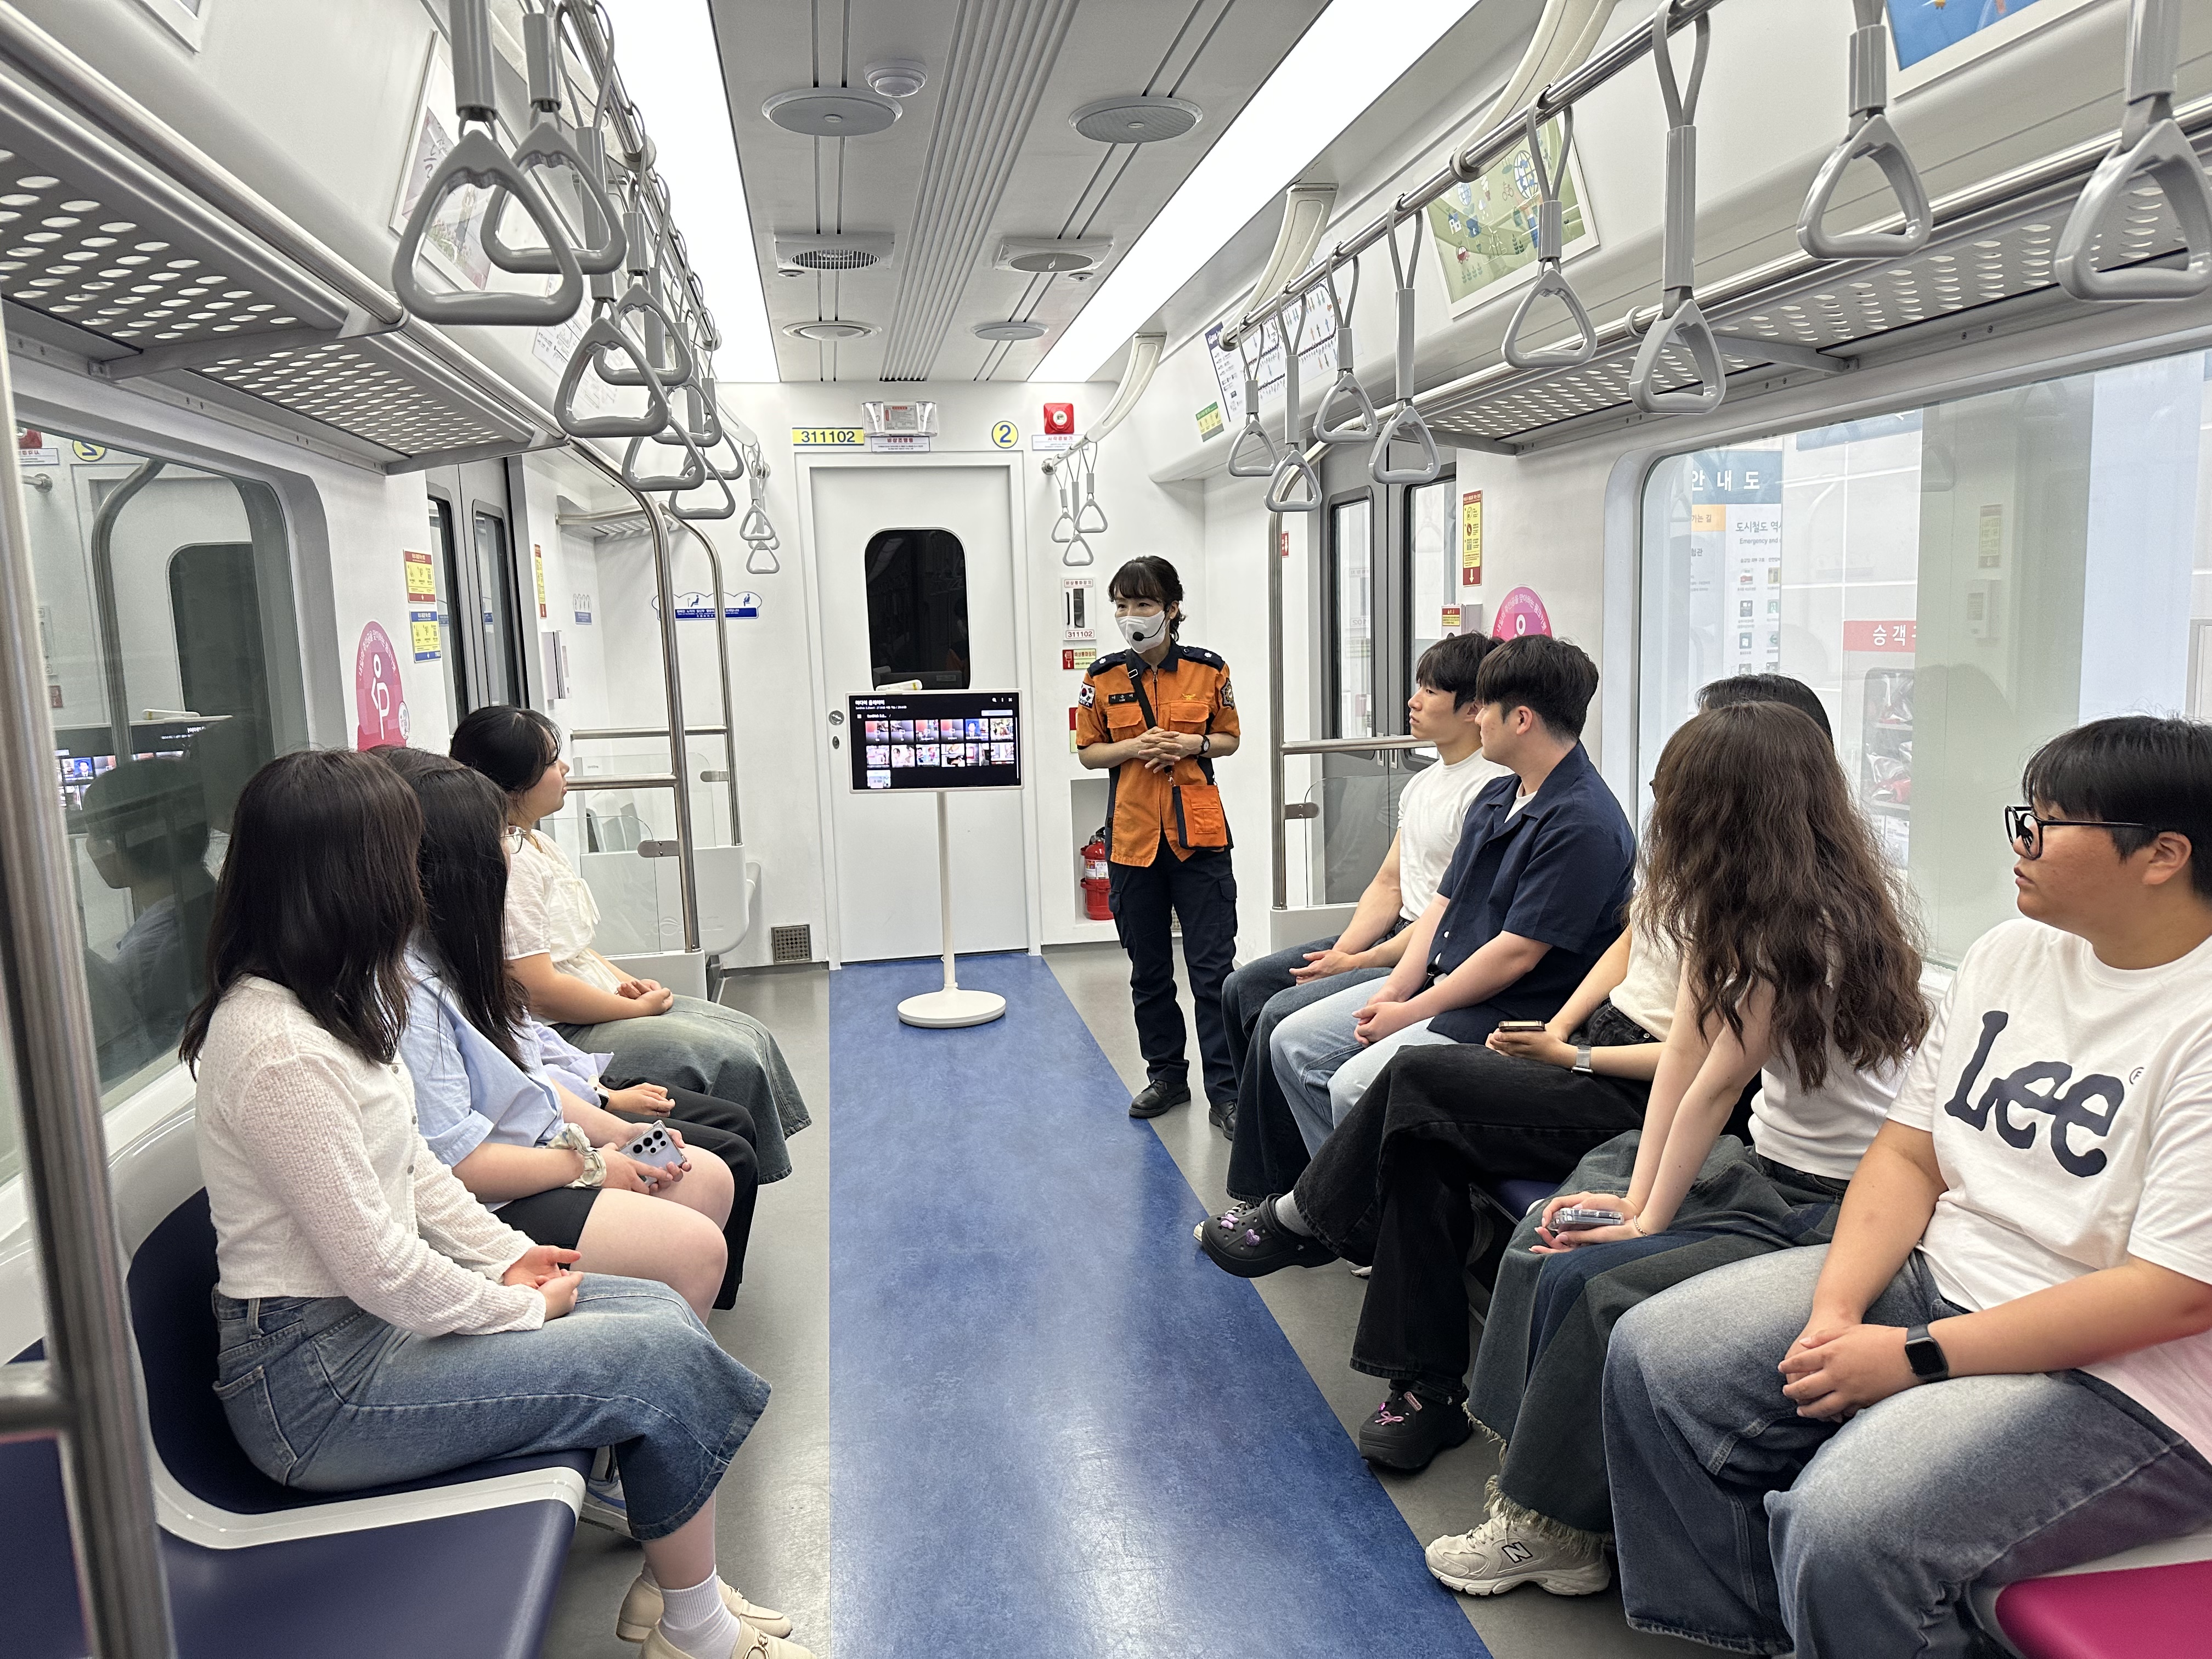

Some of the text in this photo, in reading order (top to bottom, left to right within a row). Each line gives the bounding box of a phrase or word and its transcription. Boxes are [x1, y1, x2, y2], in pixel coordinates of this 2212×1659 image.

[801, 431, 855, 443] 311102
[999, 425, 1012, 443] 2
[1735, 522, 1768, 533] 도시철도
[1944, 1011, 2125, 1177] Lee
[1502, 1542, 1533, 1563] N
